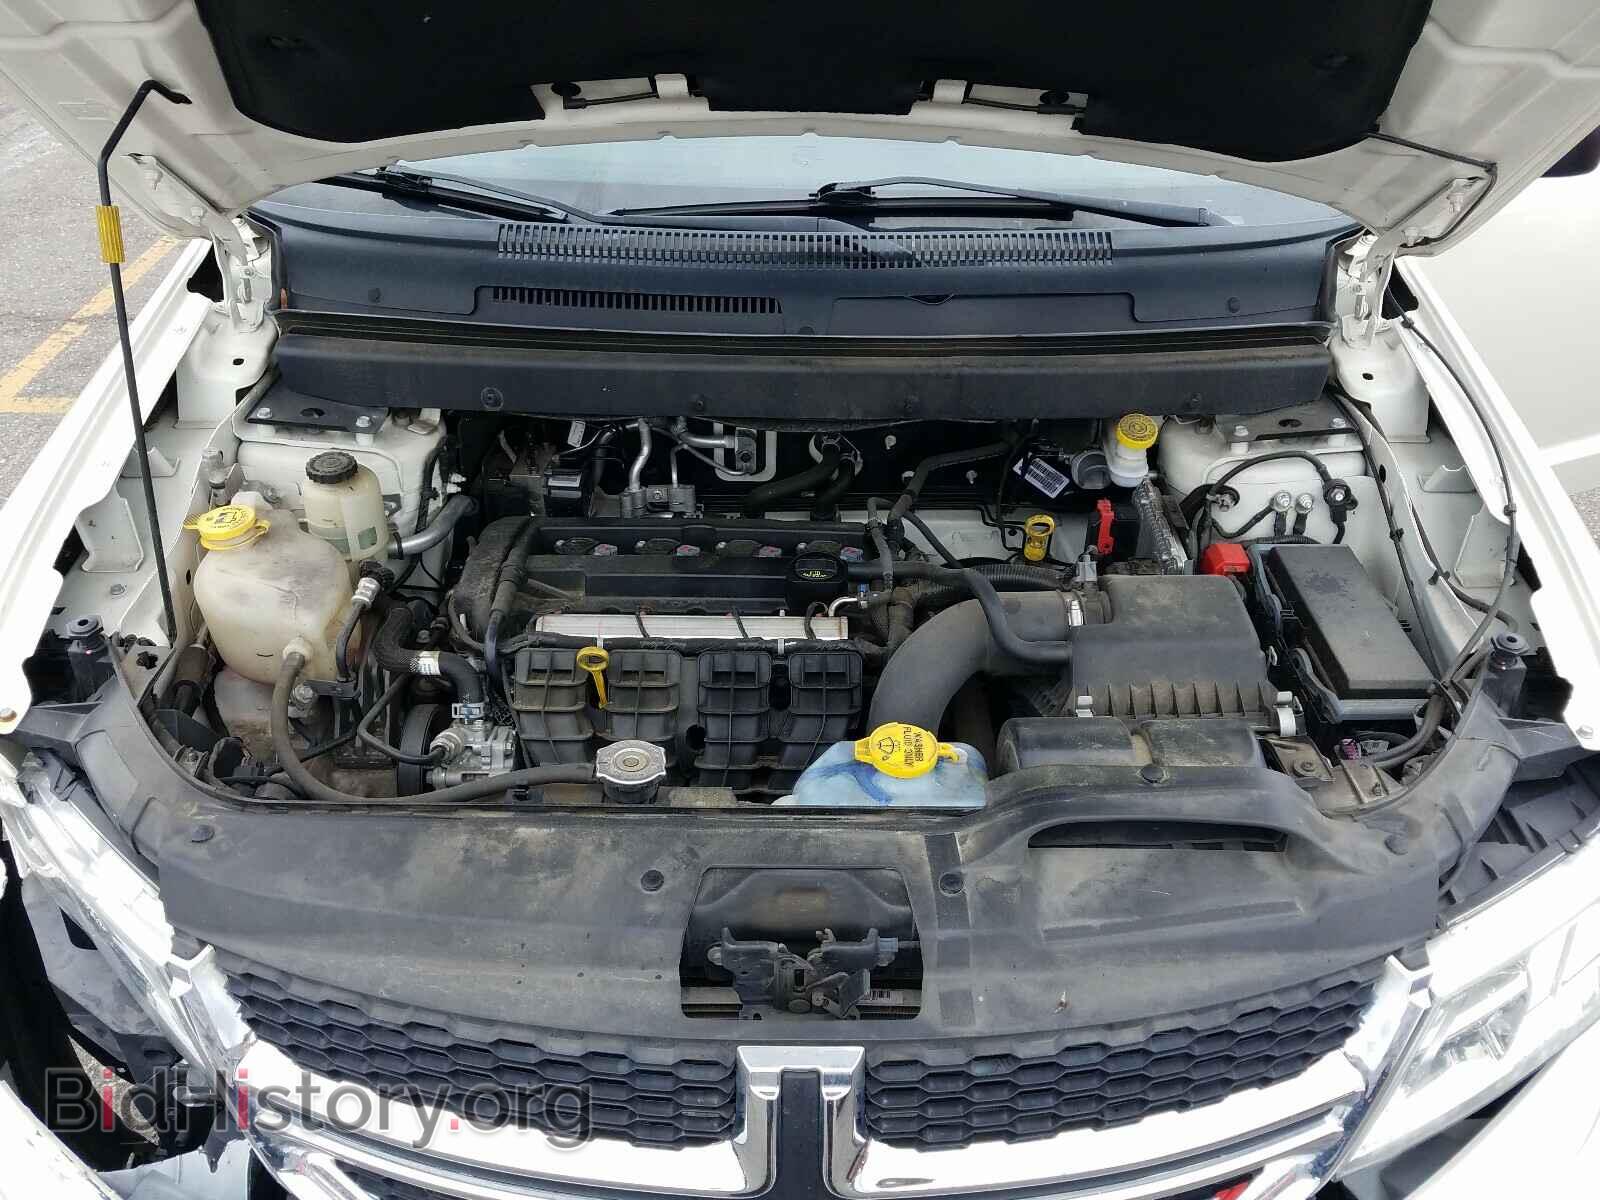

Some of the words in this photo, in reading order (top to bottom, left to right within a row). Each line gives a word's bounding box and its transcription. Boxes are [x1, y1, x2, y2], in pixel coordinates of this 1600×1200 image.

[903, 726, 912, 748] FLUID
[913, 731, 924, 762] WASHER
[904, 749, 913, 768] ONLY
